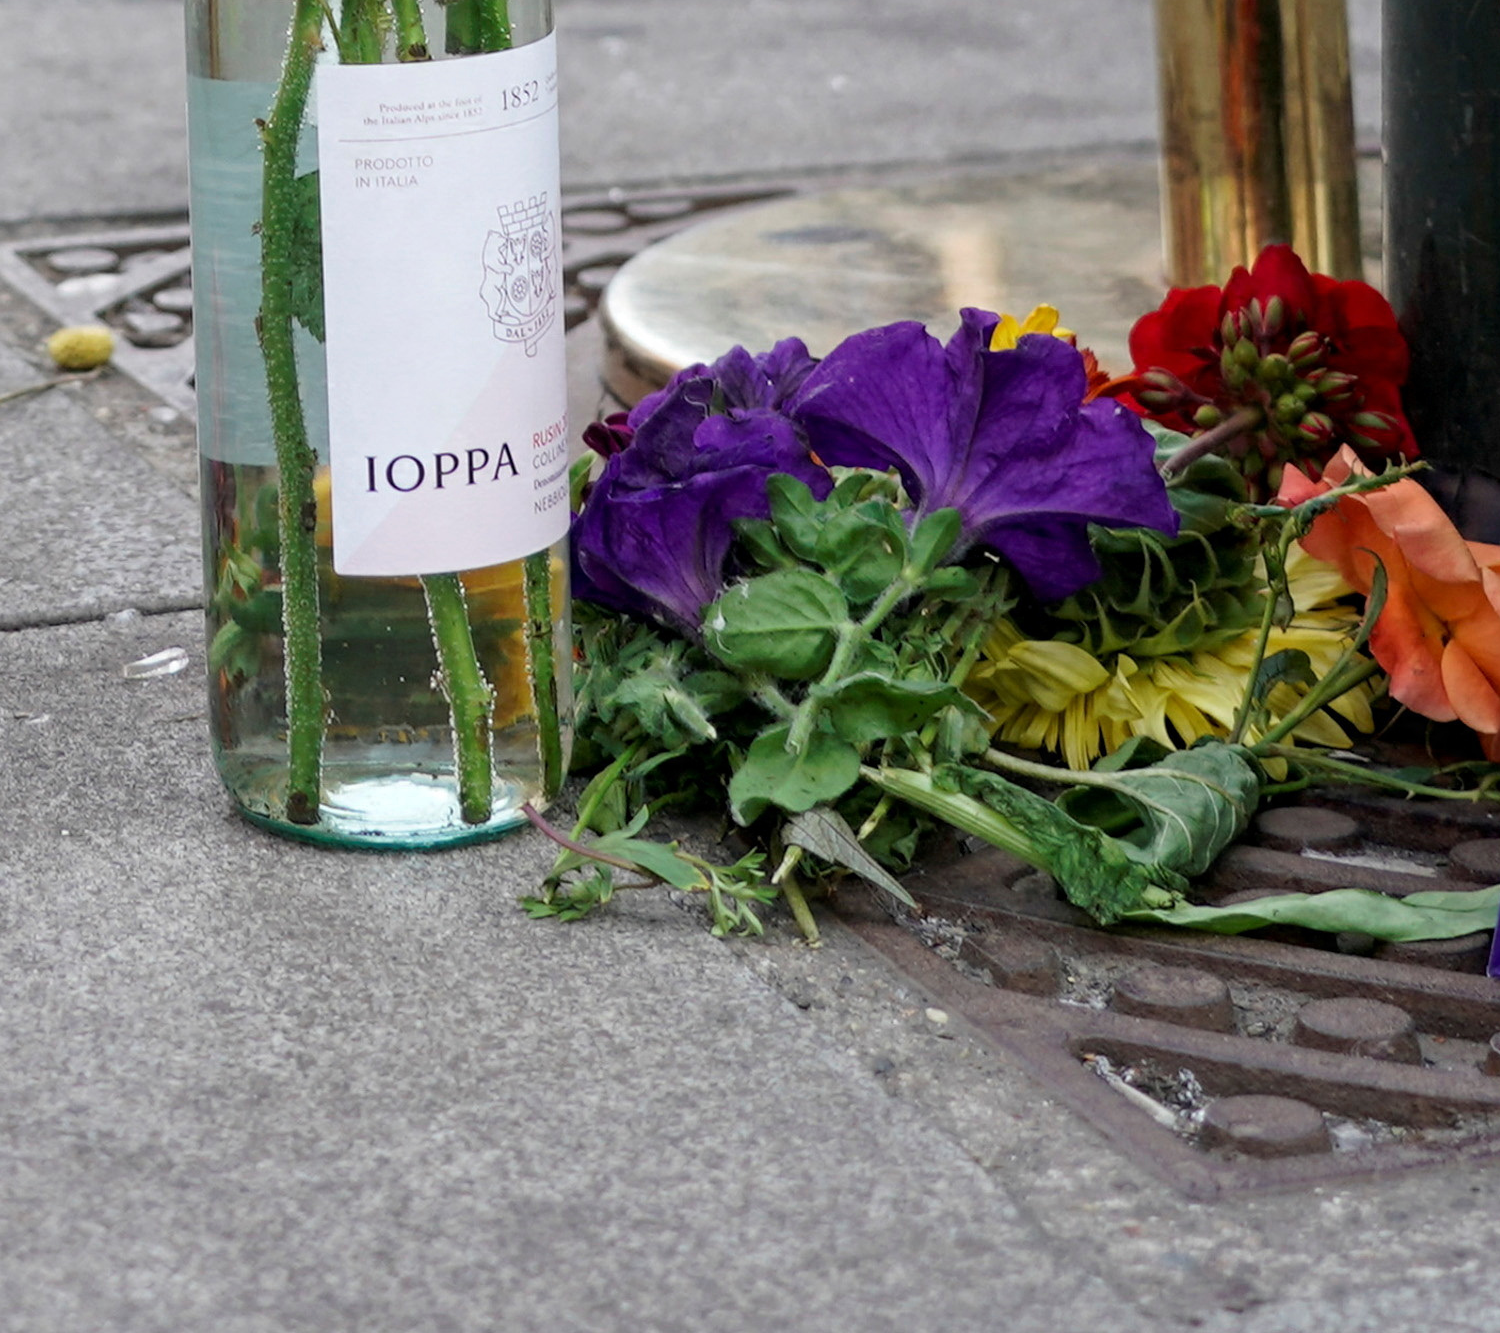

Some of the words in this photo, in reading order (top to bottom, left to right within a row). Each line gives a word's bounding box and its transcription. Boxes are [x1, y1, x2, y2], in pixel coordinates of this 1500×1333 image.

[500, 80, 540, 112] 1852
[379, 101, 425, 113] Produced
[438, 99, 451, 108] the
[363, 116, 379, 126] the
[381, 115, 412, 125] Italian
[414, 114, 436, 125] Alps
[438, 112, 460, 121] since
[354, 154, 434, 171] PRODOTTO
[355, 176, 371, 188] IN
[375, 174, 420, 188] ITALIA
[364, 442, 520, 493] IOPPA
